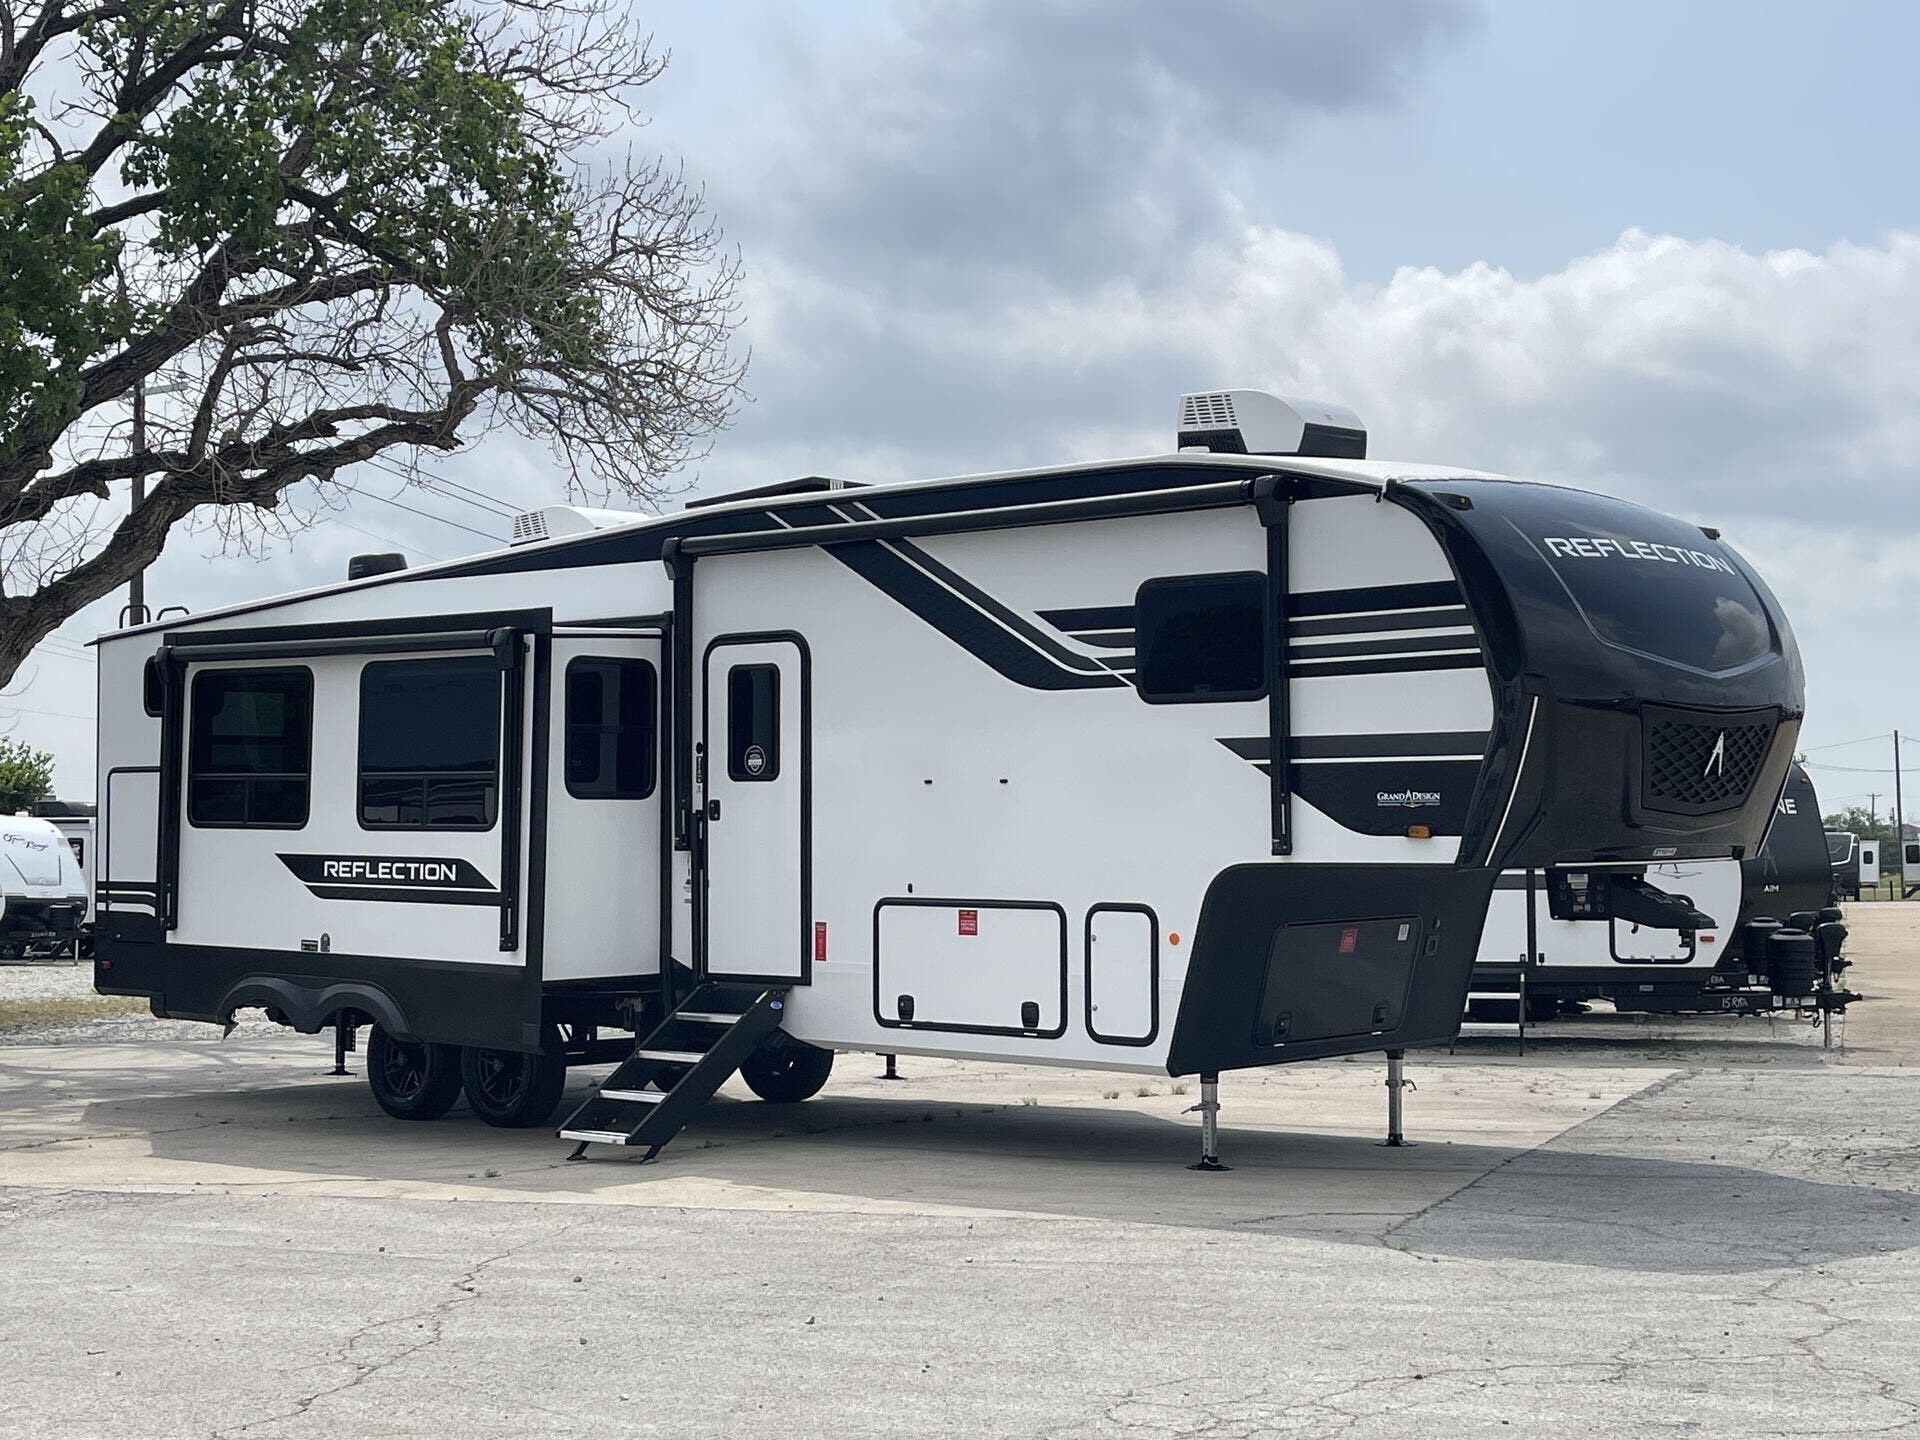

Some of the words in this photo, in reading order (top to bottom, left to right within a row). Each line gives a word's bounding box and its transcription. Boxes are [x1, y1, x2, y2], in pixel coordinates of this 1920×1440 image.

[1543, 537, 1736, 576] REFLECTION
[1377, 792, 1405, 800] GRAND
[1412, 792, 1440, 800] DESIGN
[323, 860, 457, 882] REFLECTION
[1764, 885, 1779, 893] AIM
